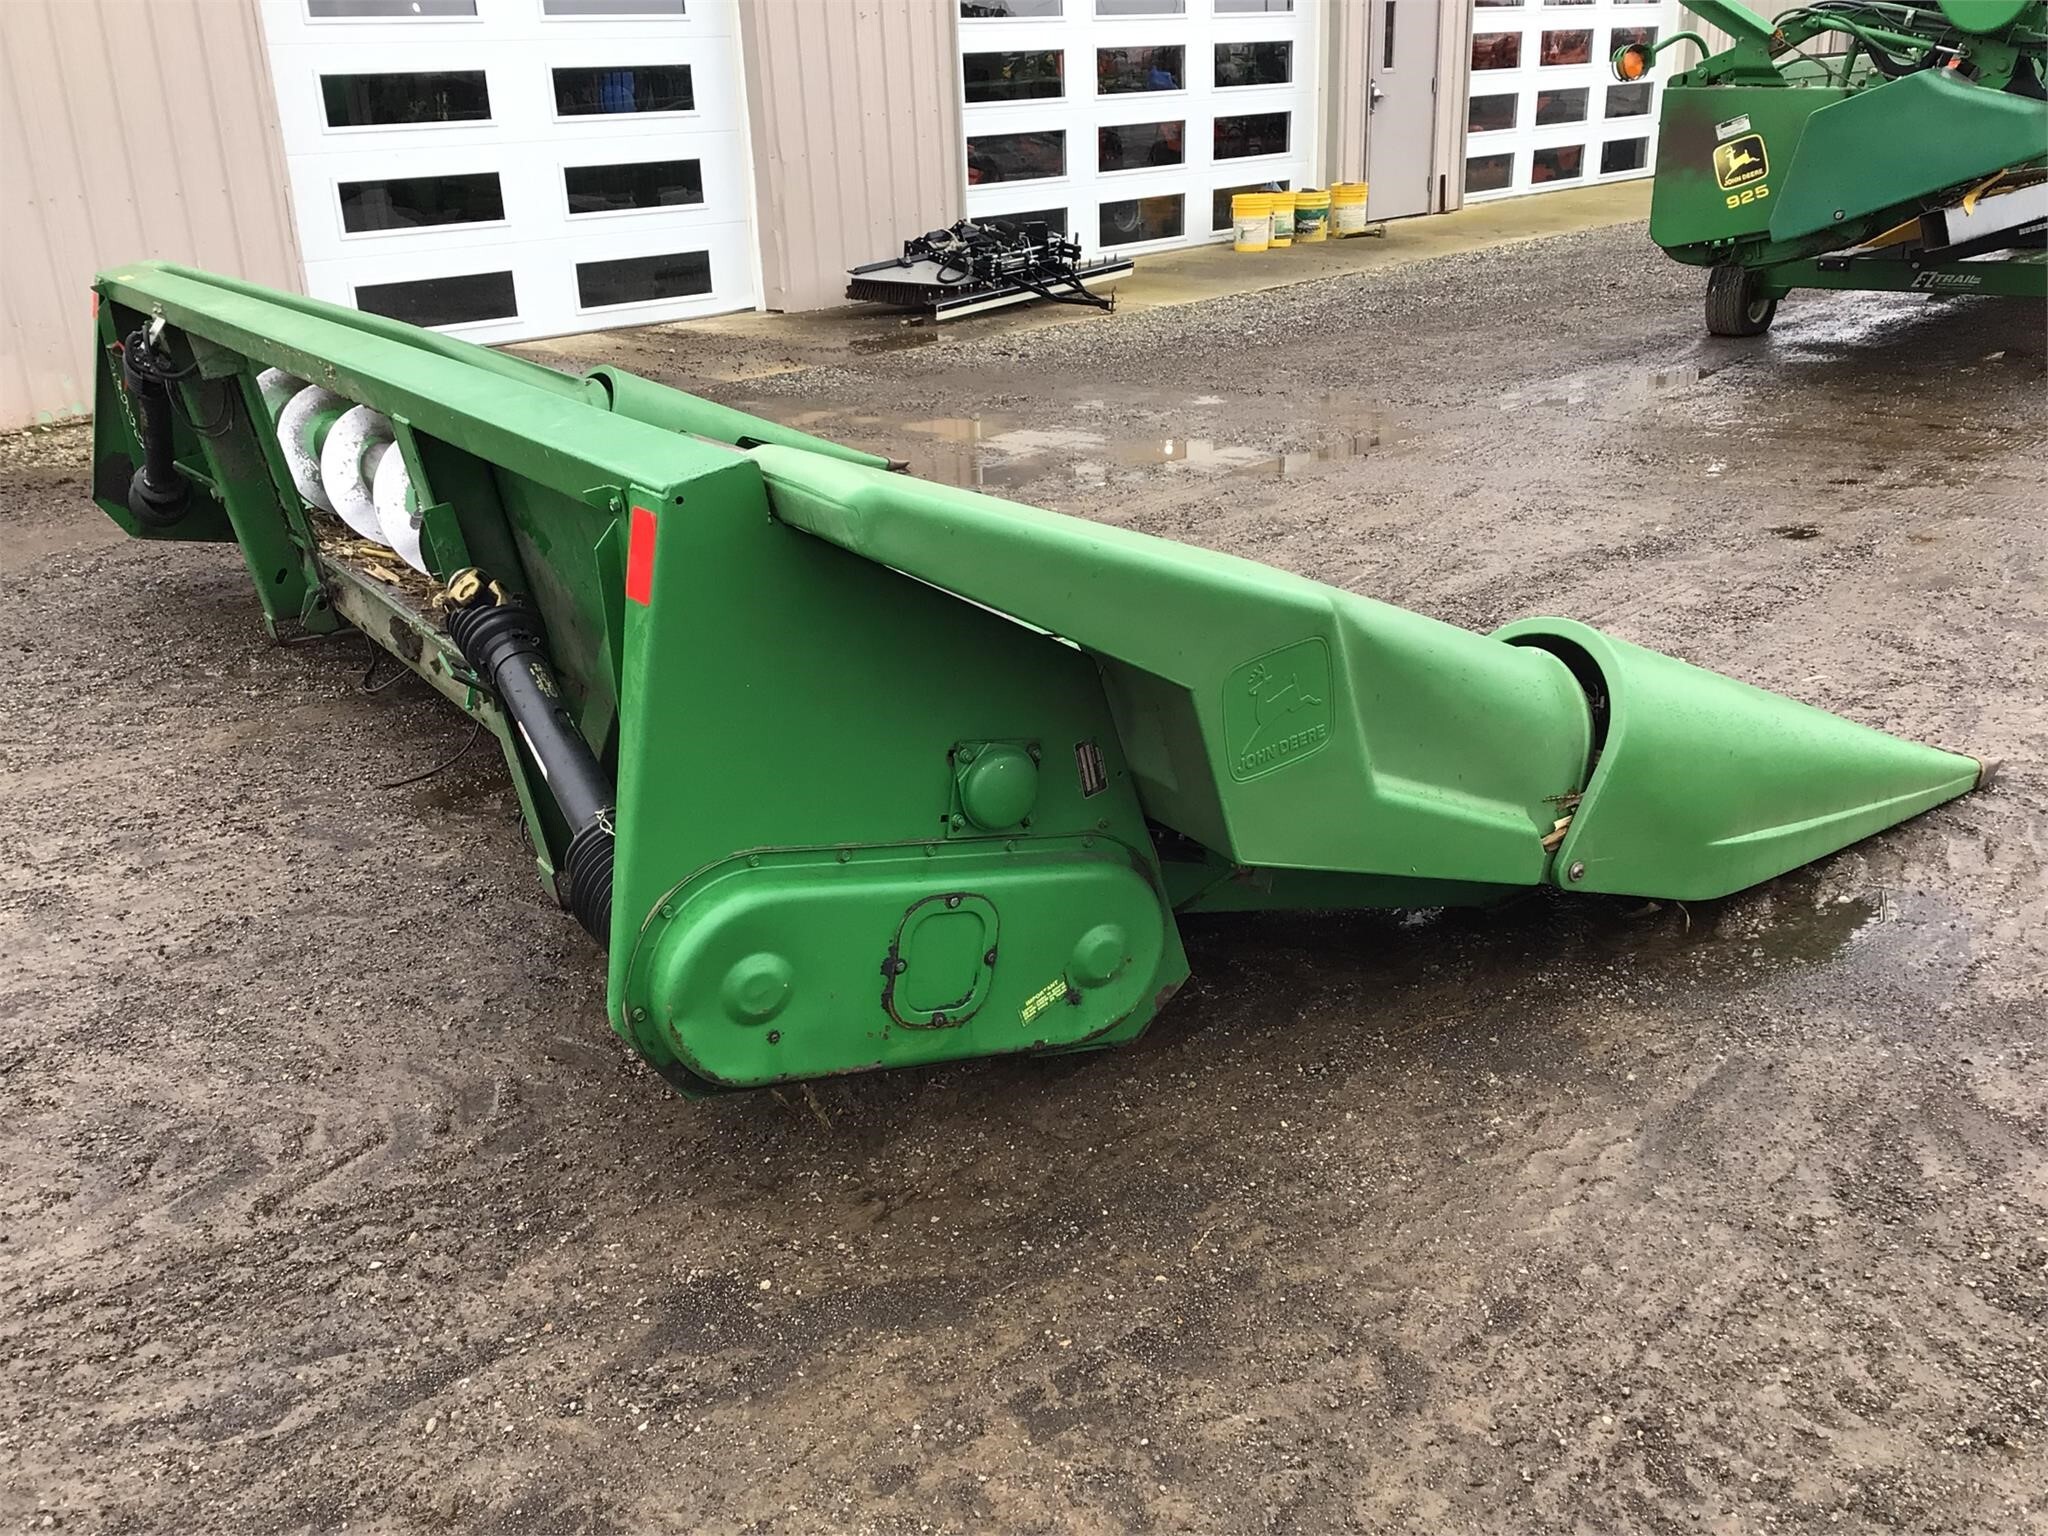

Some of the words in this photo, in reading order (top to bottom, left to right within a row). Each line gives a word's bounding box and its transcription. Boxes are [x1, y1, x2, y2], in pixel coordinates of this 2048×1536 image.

[1723, 175, 1742, 187] JOHN
[1742, 168, 1765, 181] DEERE
[1726, 184, 1770, 209] 925
[1936, 274, 1982, 284] TRAIL
[1236, 743, 1276, 774] JOHN
[1279, 723, 1326, 756] DEERE
[1025, 979, 1058, 1006] IMPORTANT
